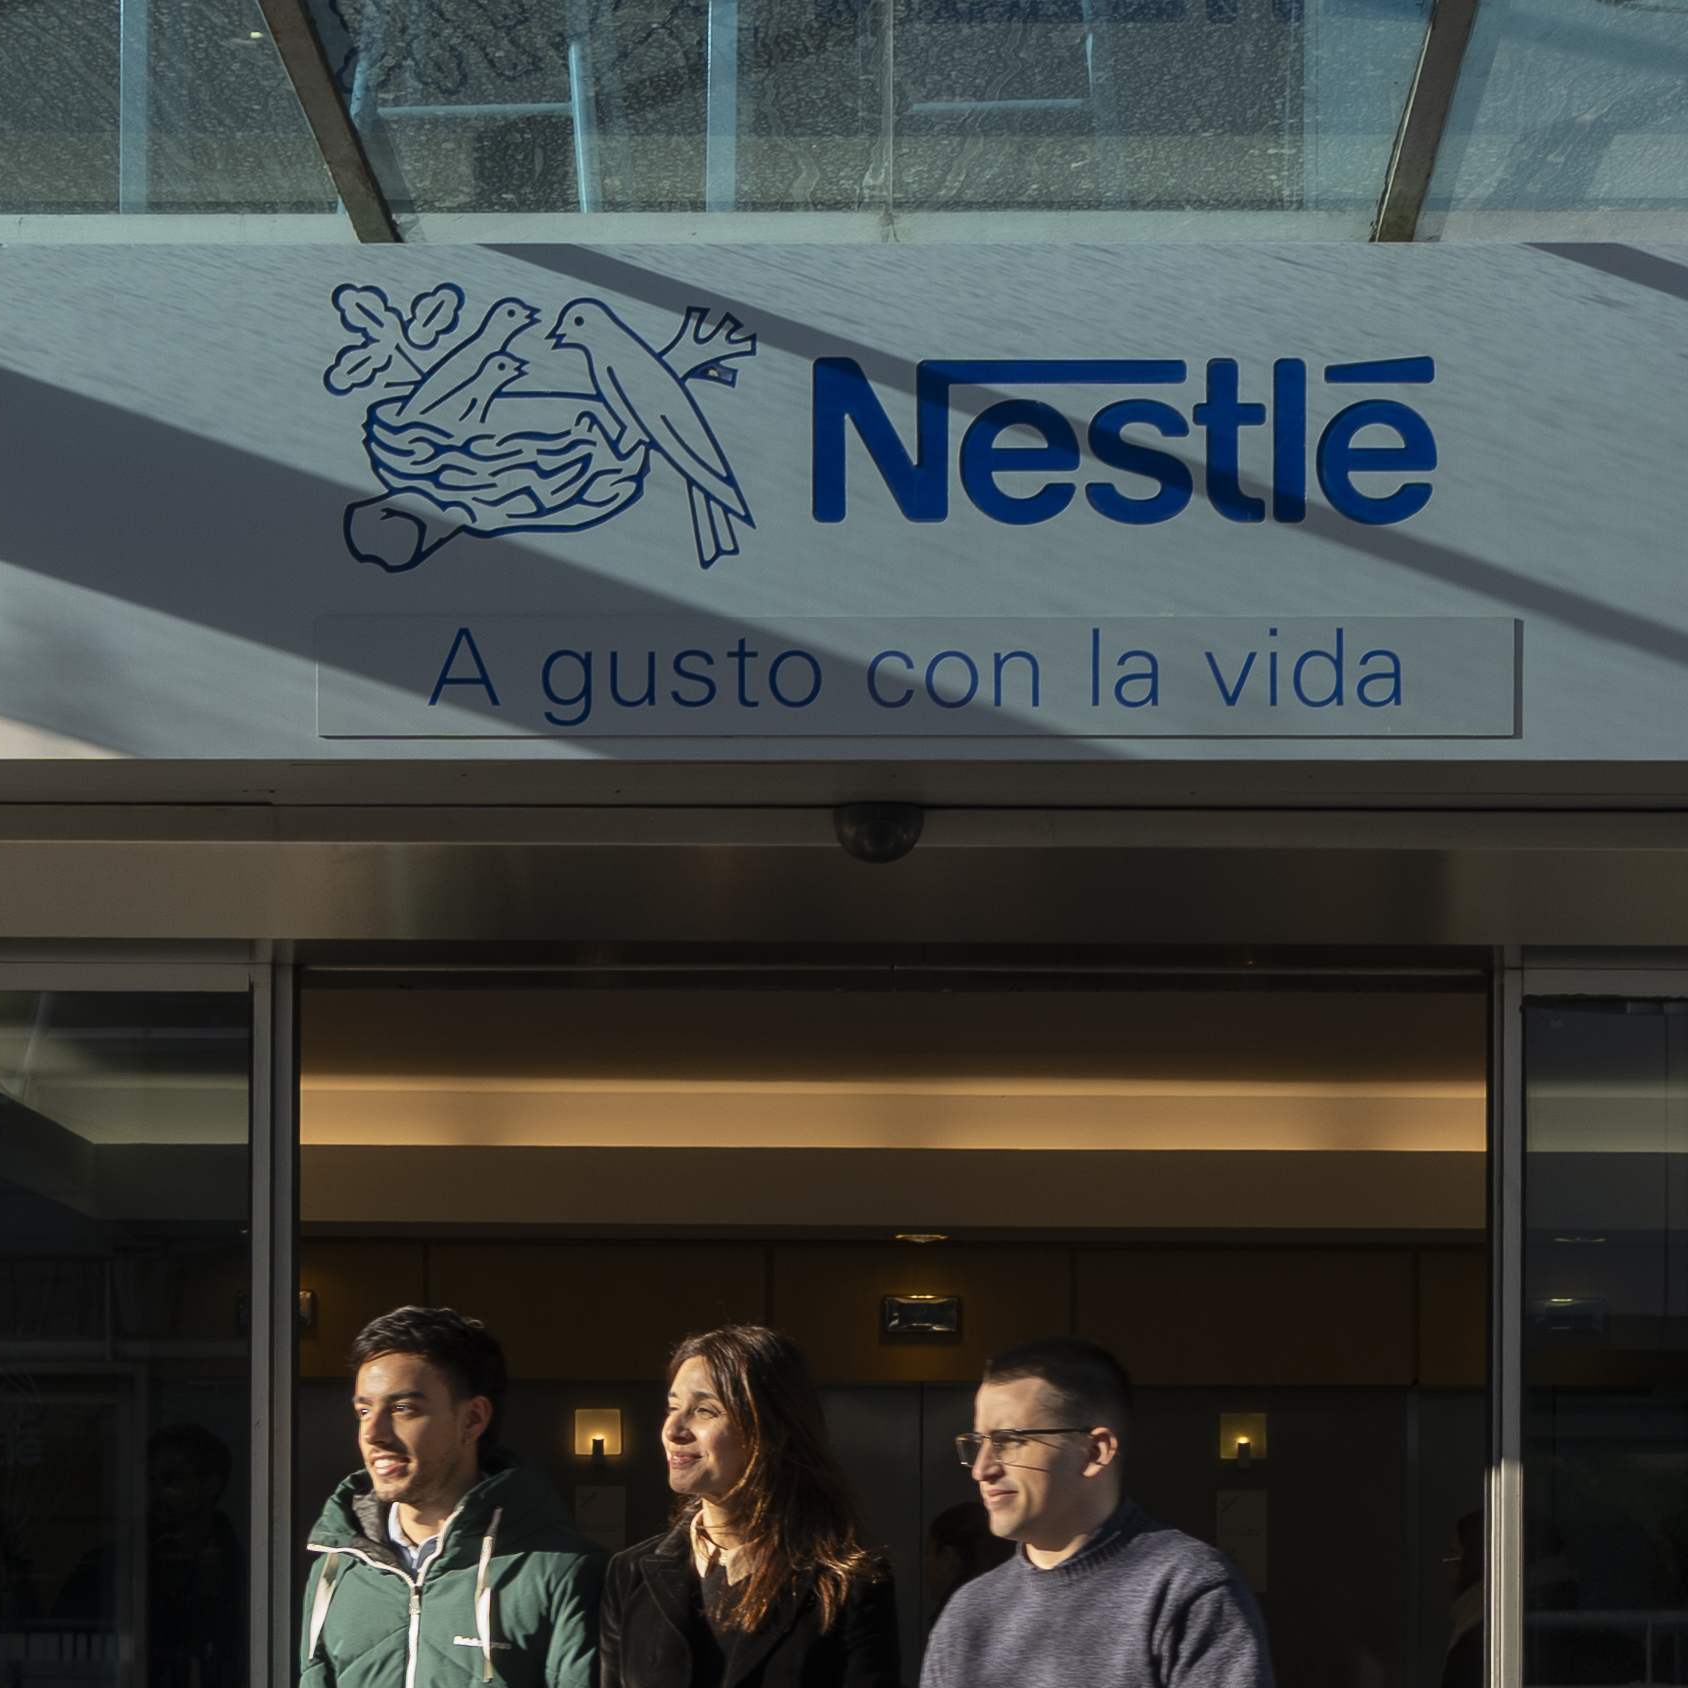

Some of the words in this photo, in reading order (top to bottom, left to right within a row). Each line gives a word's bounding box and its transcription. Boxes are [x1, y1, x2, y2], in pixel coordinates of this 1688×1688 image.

[811, 356, 1437, 525] Nestlé
[429, 628, 499, 707] A
[540, 634, 823, 727] gusto
[866, 645, 1042, 708] con
[1091, 628, 1161, 708] la
[1202, 628, 1404, 708] vida
